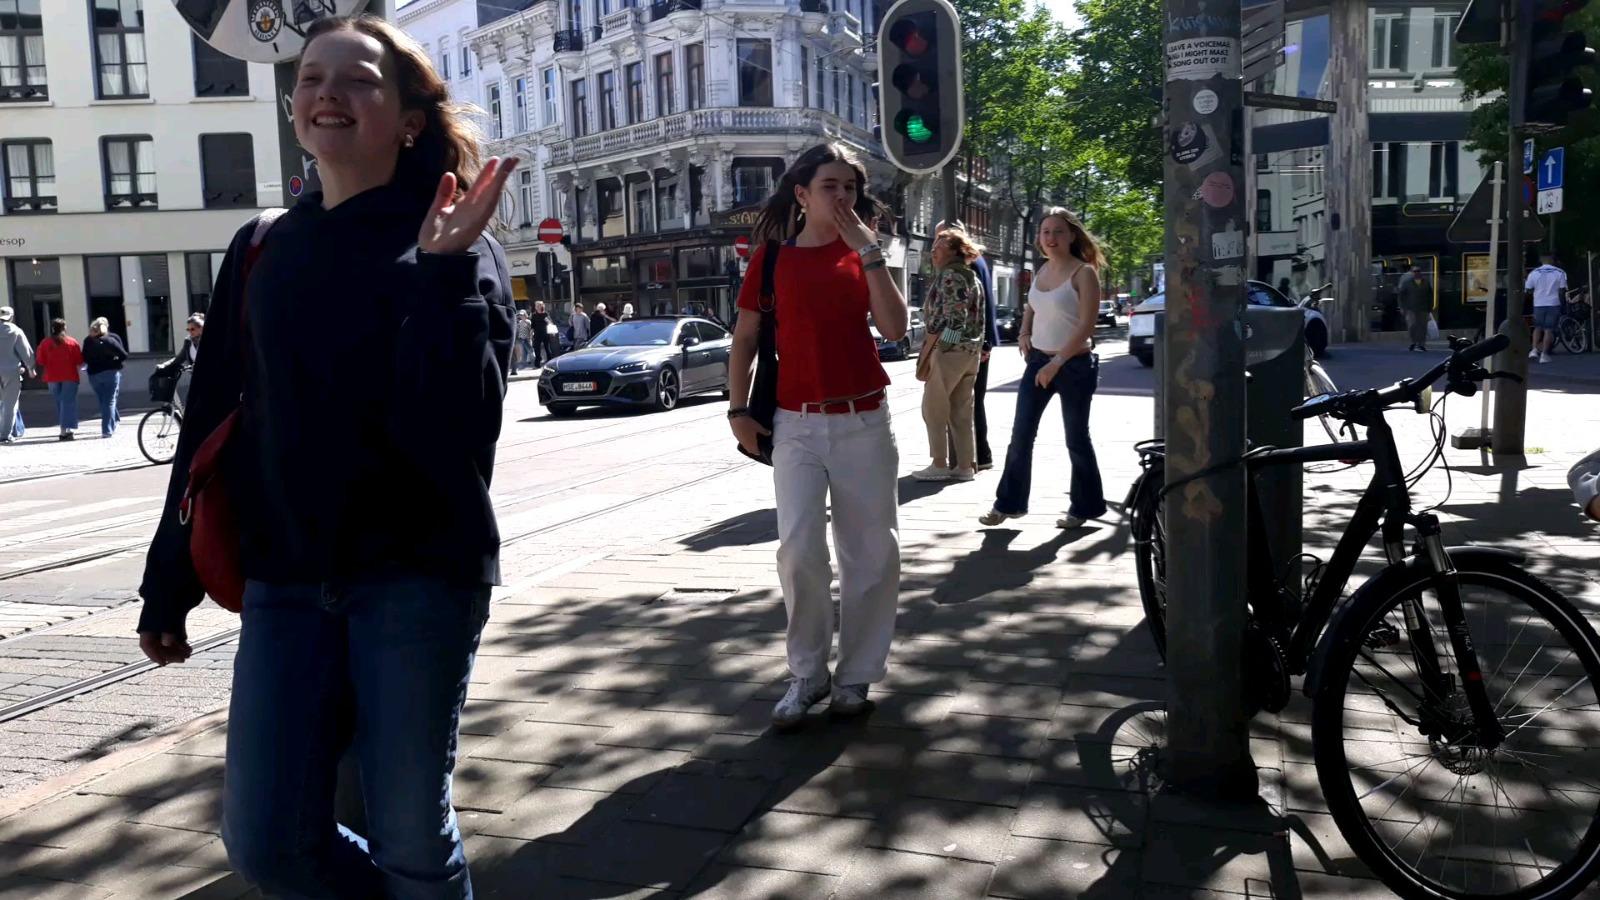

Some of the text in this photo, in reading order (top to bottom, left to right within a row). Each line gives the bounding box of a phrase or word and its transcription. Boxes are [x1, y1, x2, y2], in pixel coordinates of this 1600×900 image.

[1185, 49, 1207, 57] MIGHT
[1173, 59, 1191, 67] SONG
[1193, 57, 1208, 65] OUT
